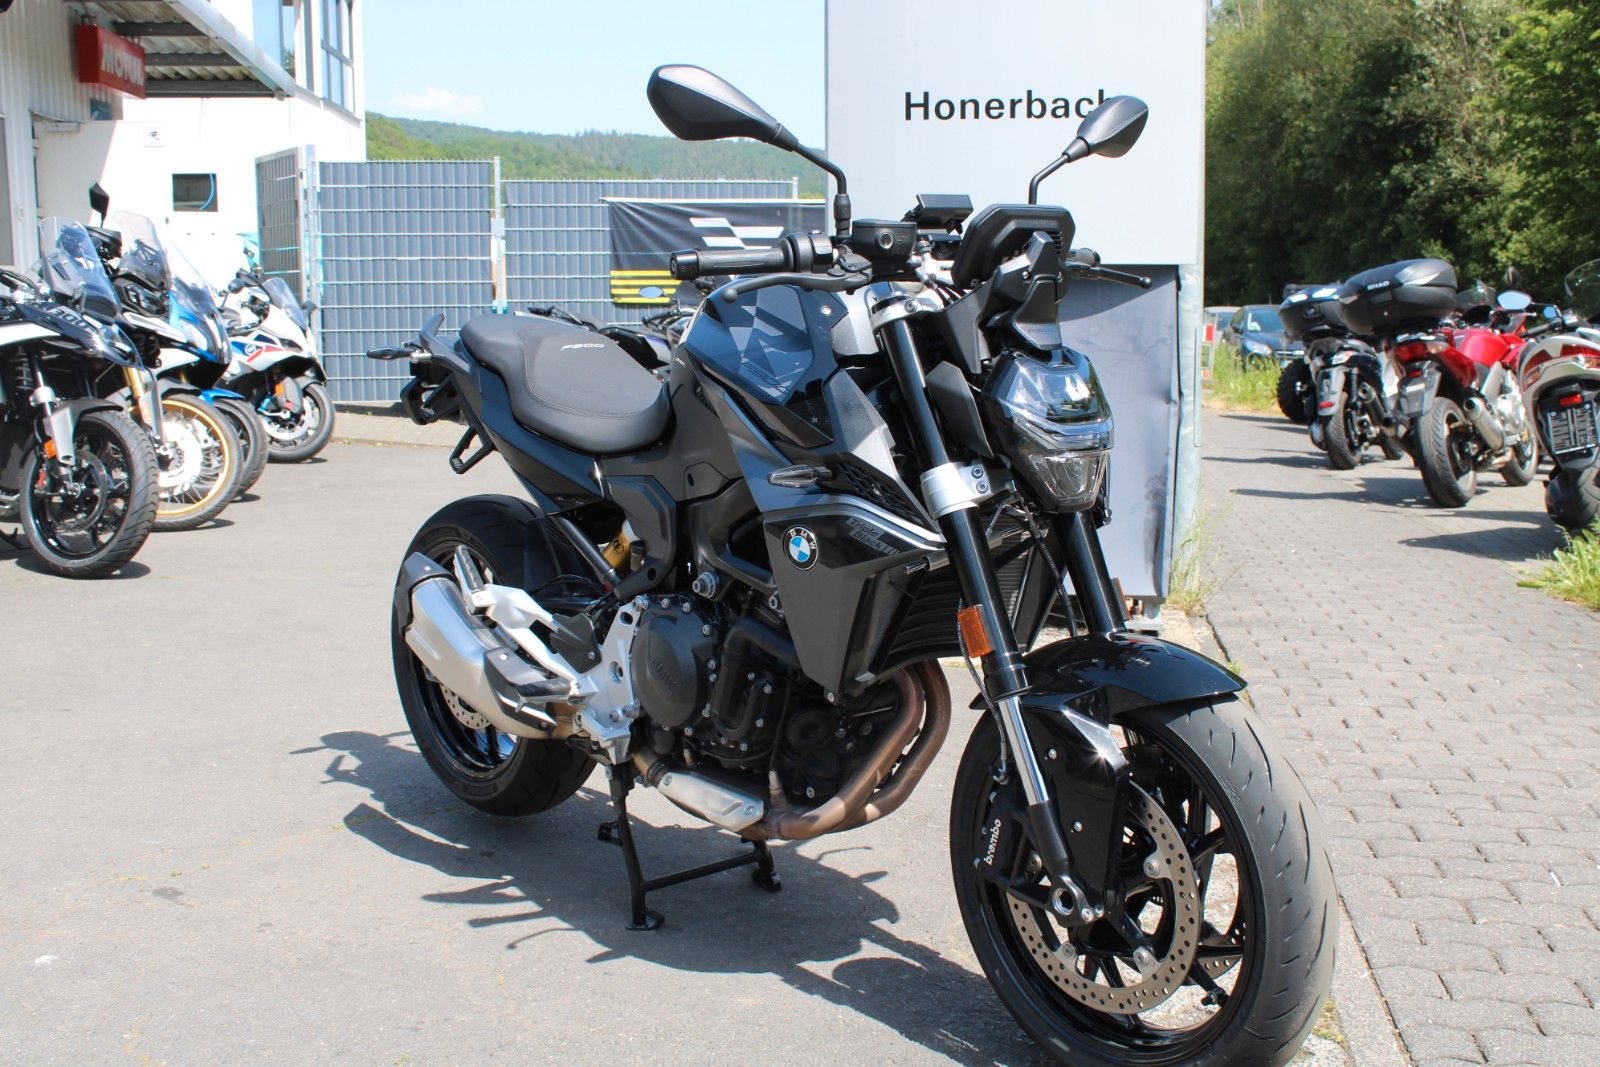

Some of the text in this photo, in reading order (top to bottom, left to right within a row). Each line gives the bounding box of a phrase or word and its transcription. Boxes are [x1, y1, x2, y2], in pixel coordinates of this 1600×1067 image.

[849, 518, 880, 538] Triple
[789, 528, 817, 550] BMW
[852, 531, 883, 550] Black
[983, 818, 1002, 867] brembo
